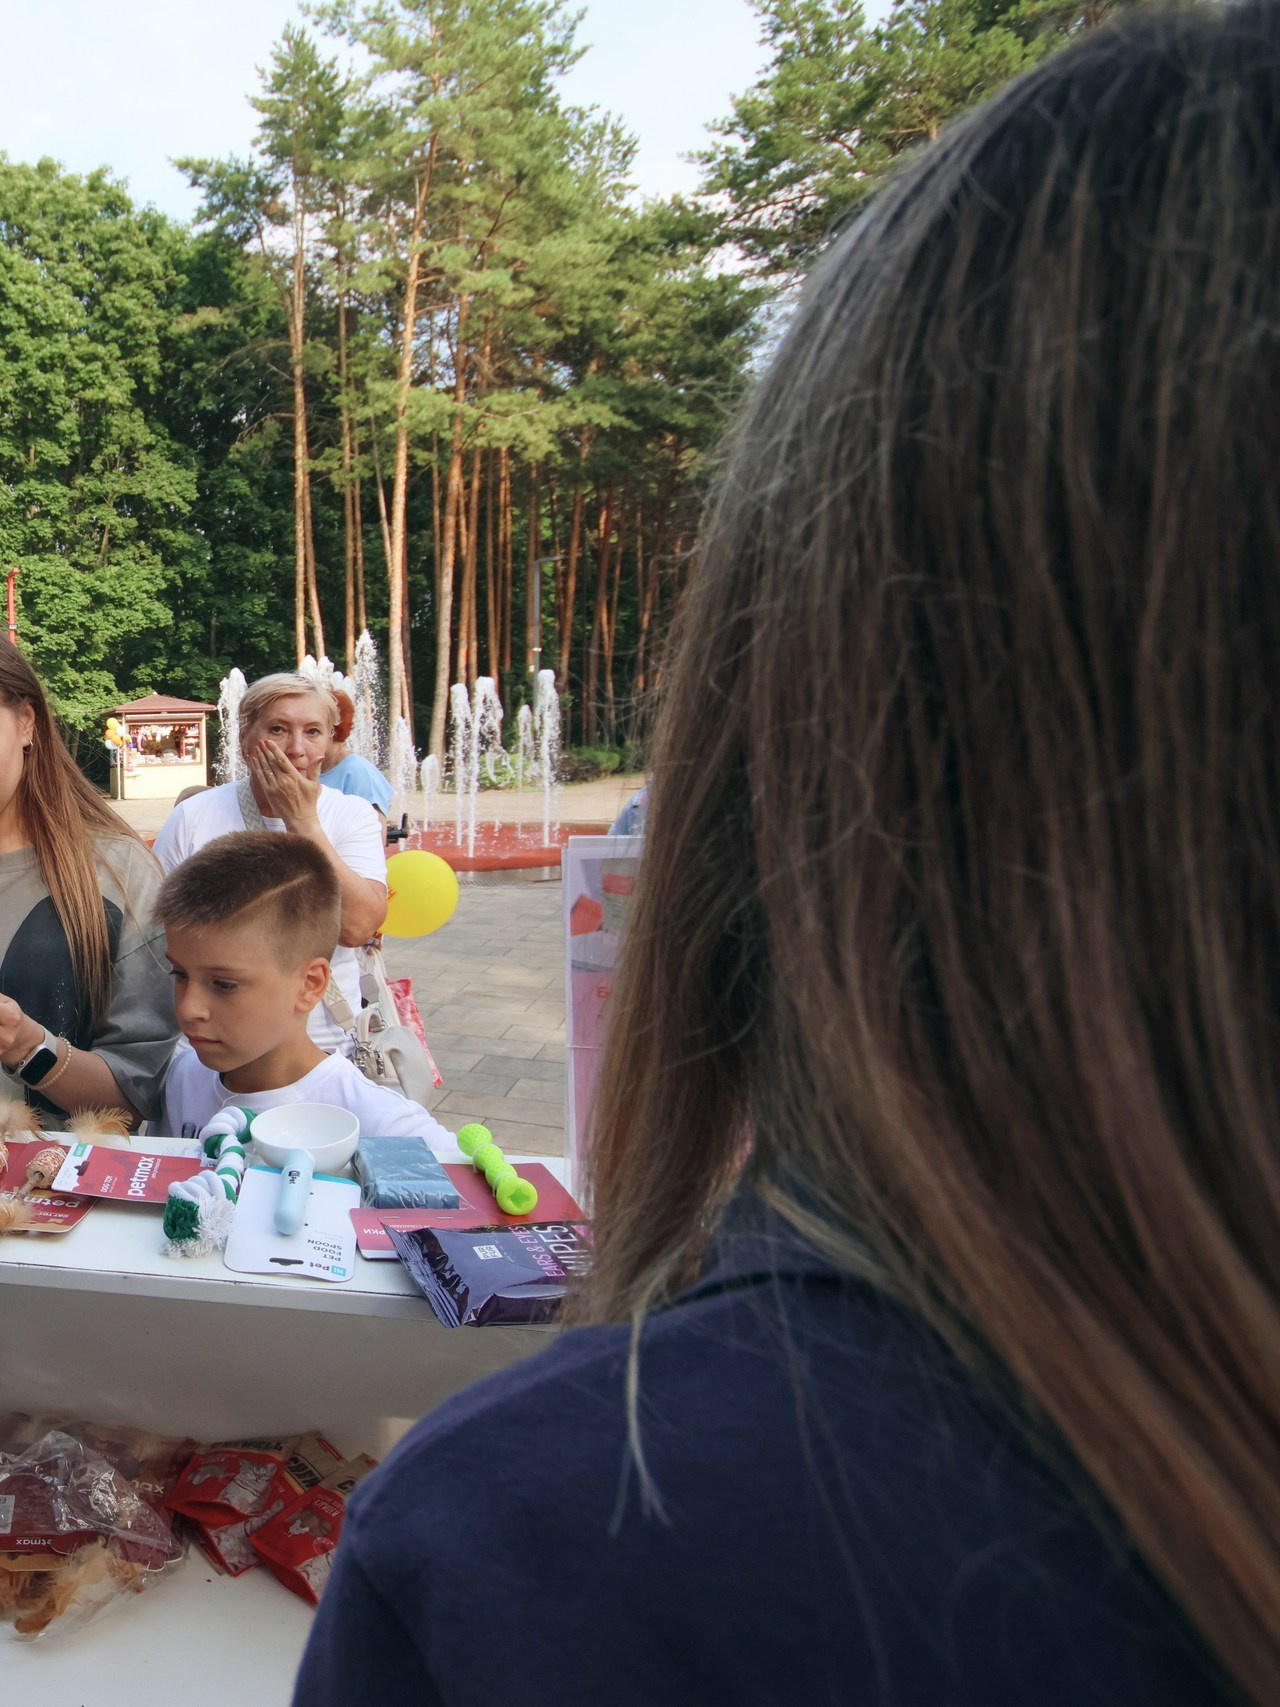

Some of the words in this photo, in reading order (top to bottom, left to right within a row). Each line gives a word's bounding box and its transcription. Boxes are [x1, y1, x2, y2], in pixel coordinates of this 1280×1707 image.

[127, 1156, 156, 1197] petmax
[508, 1226, 538, 1244] EYES
[307, 1239, 343, 1250] SPOON
[313, 1246, 342, 1256] FOOD
[322, 1253, 342, 1262] PET
[532, 1254, 566, 1277] EARS
